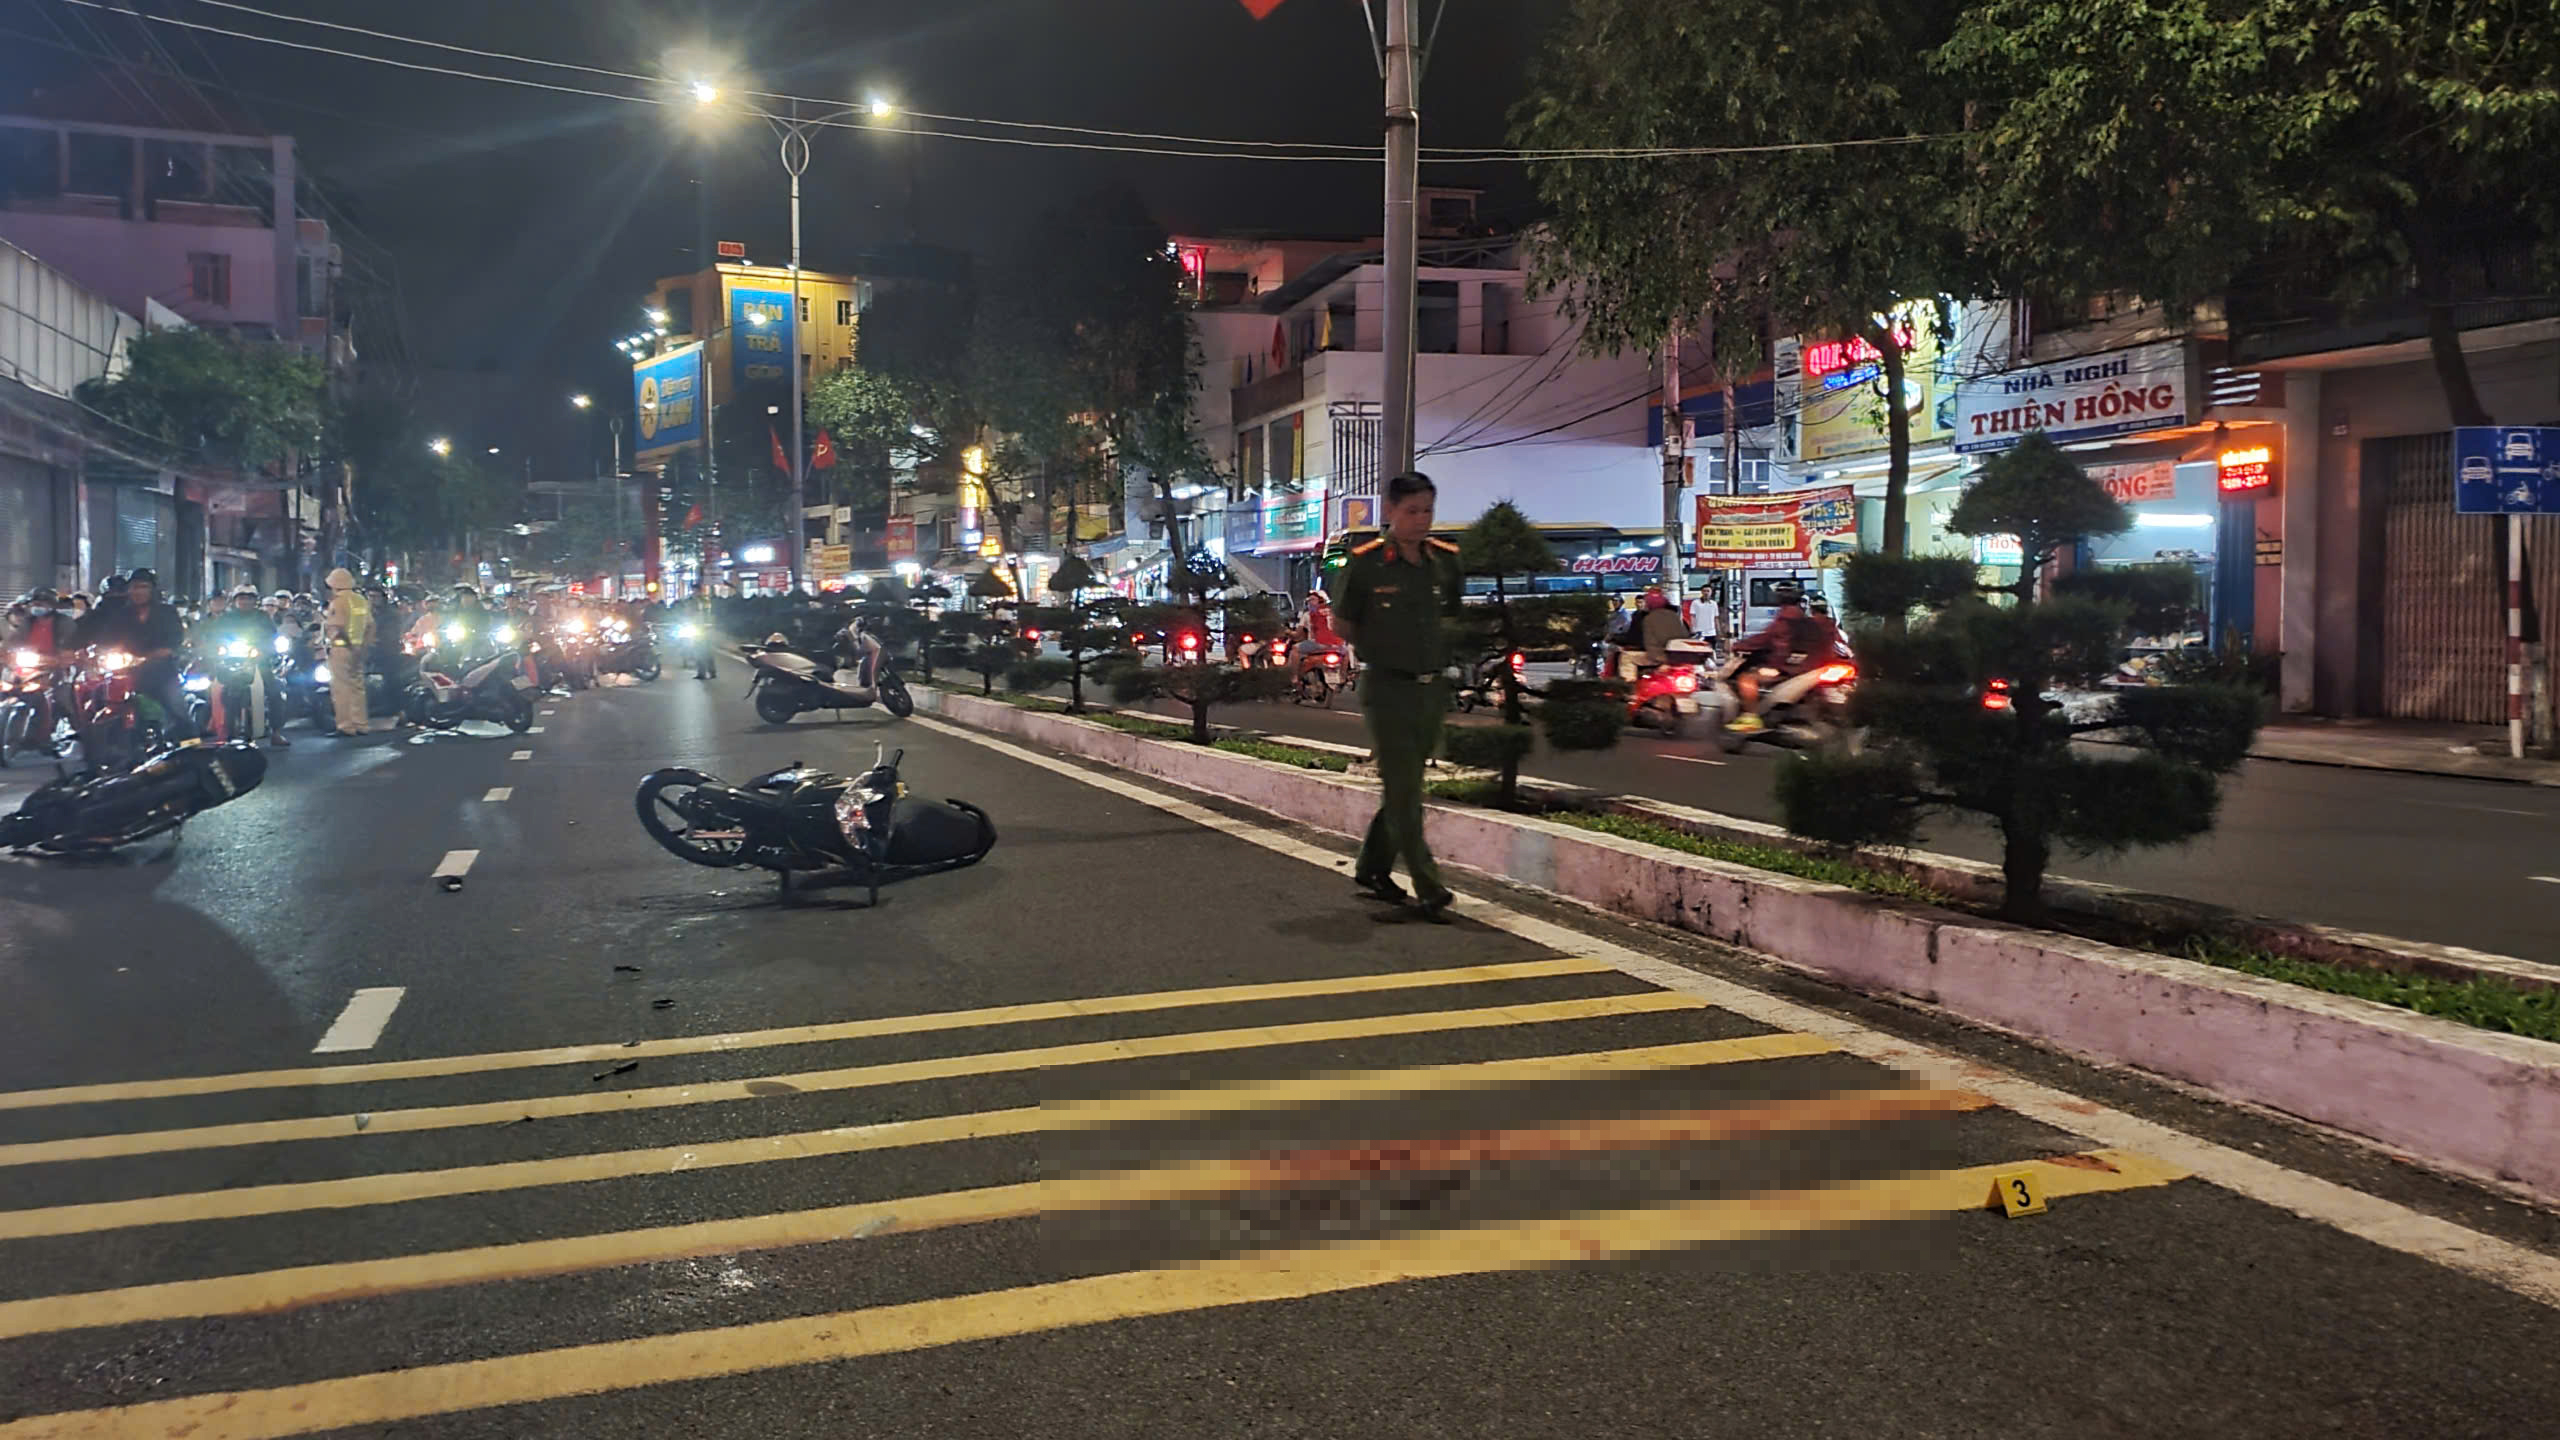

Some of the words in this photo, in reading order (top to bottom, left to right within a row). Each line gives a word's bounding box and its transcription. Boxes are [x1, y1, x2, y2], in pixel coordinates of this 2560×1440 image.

[2064, 353, 2129, 385] NGHỈ
[2074, 381, 2175, 422] HỒNG
[2012, 1179, 2031, 1208] 3
